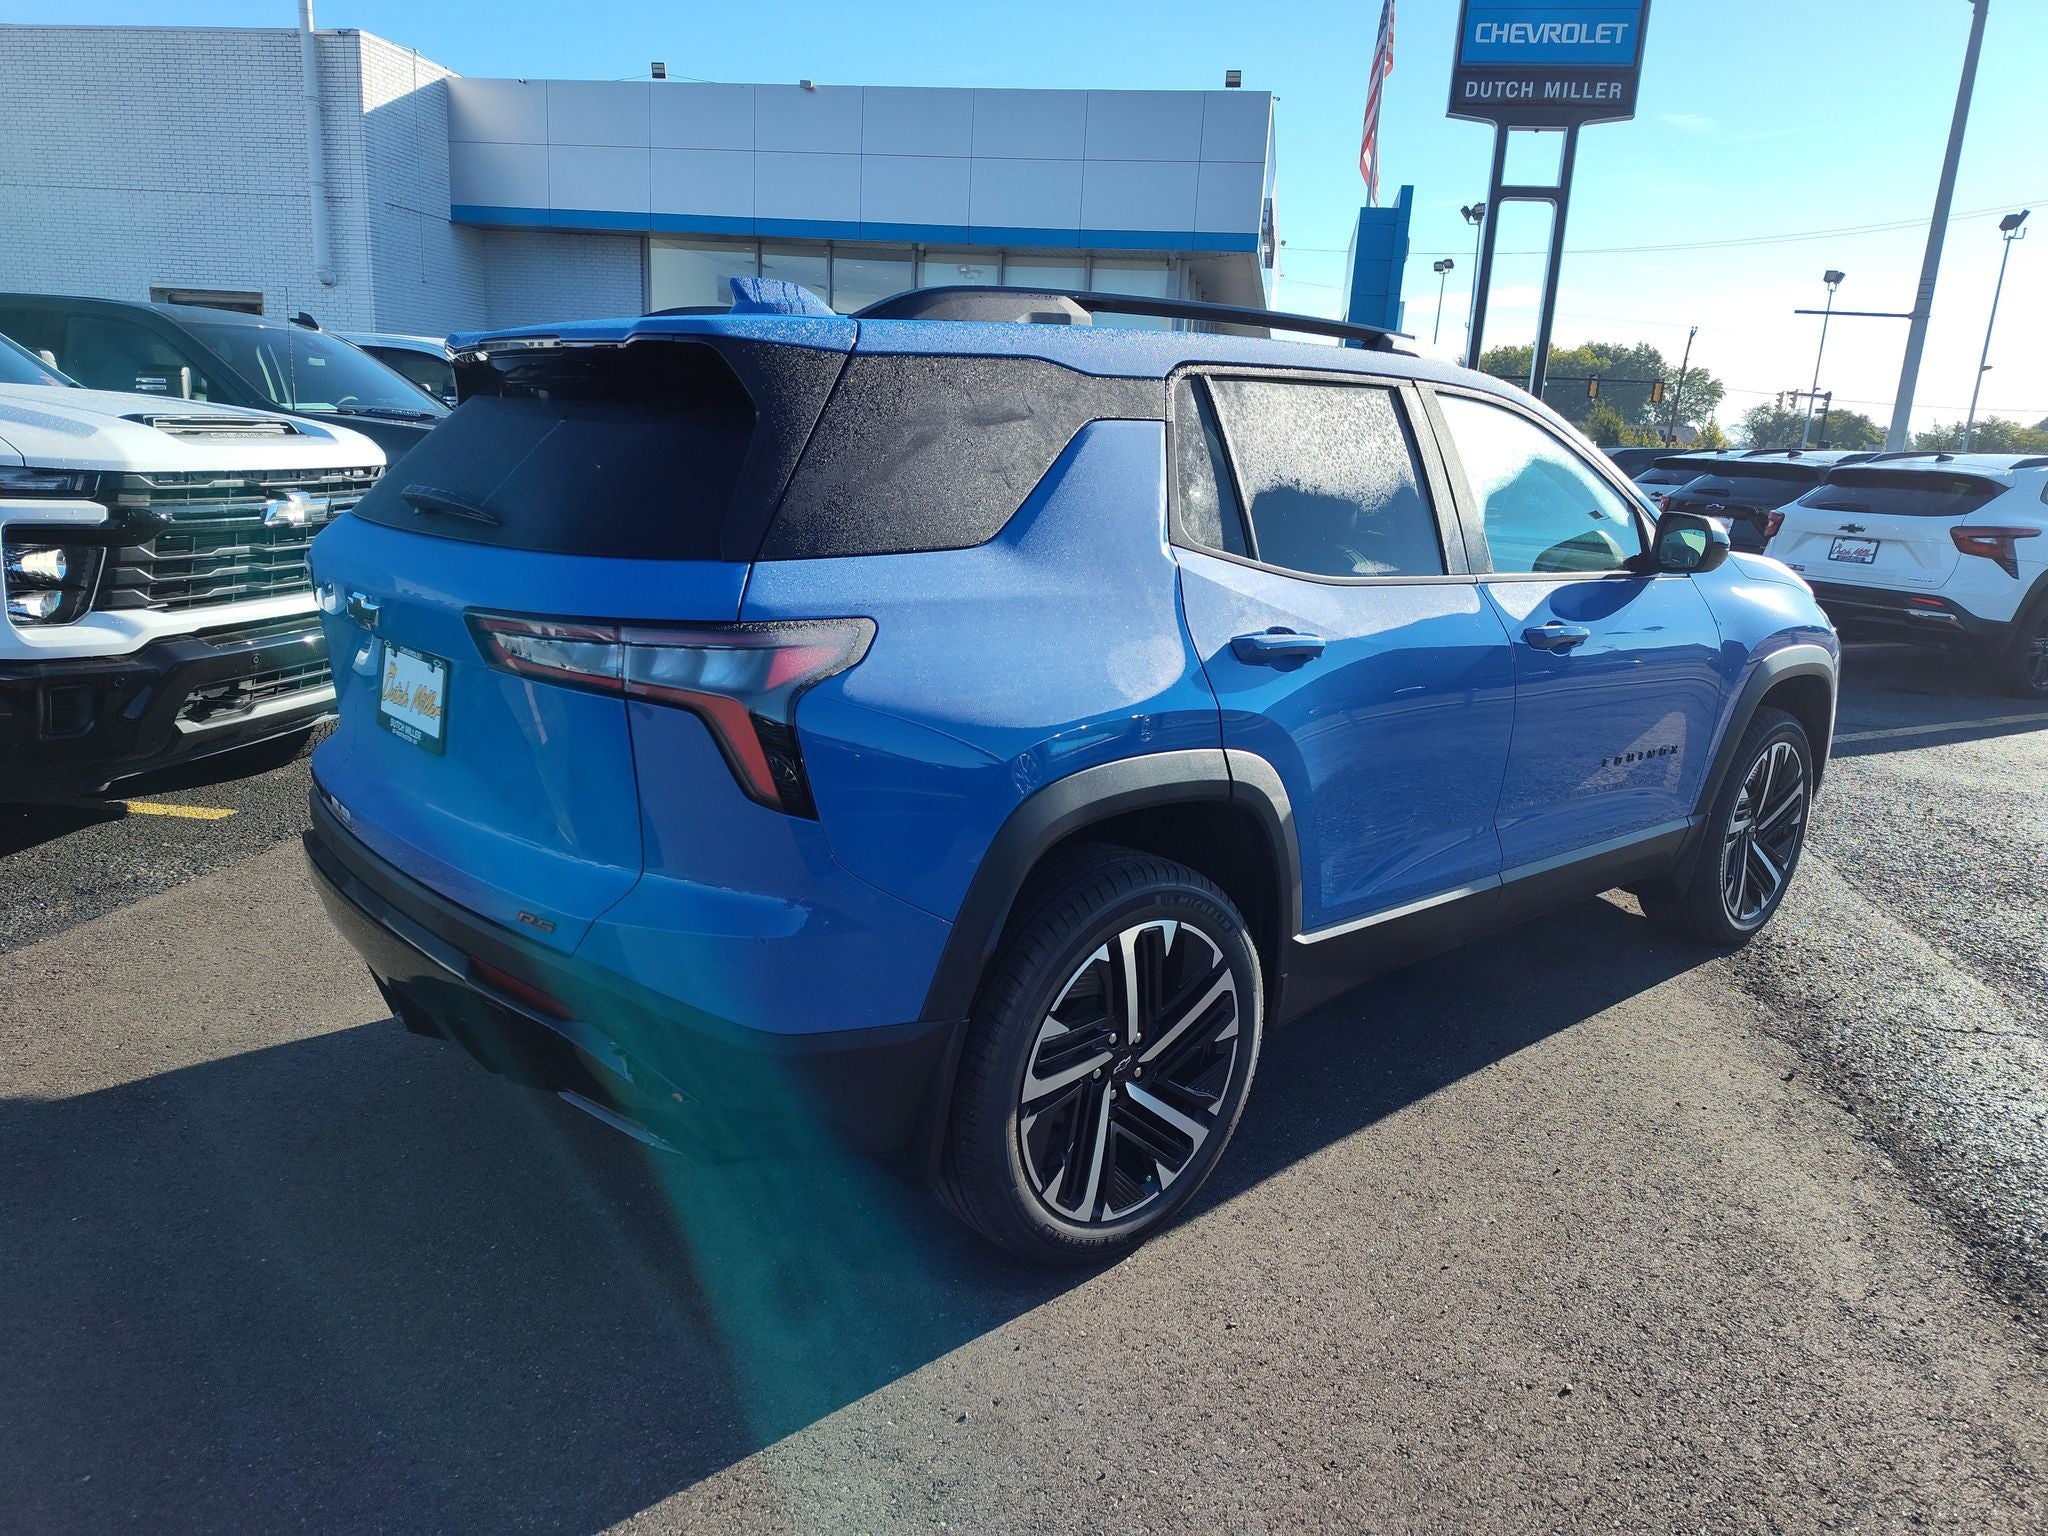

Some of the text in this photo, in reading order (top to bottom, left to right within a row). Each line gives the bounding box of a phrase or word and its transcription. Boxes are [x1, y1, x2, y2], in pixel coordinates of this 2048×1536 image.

[1475, 22, 1629, 44] CHEVROLET
[1465, 81, 1622, 99] DUTCH MILLER
[517, 911, 556, 932] RS
[1178, 896, 1232, 932] MICHELIN
